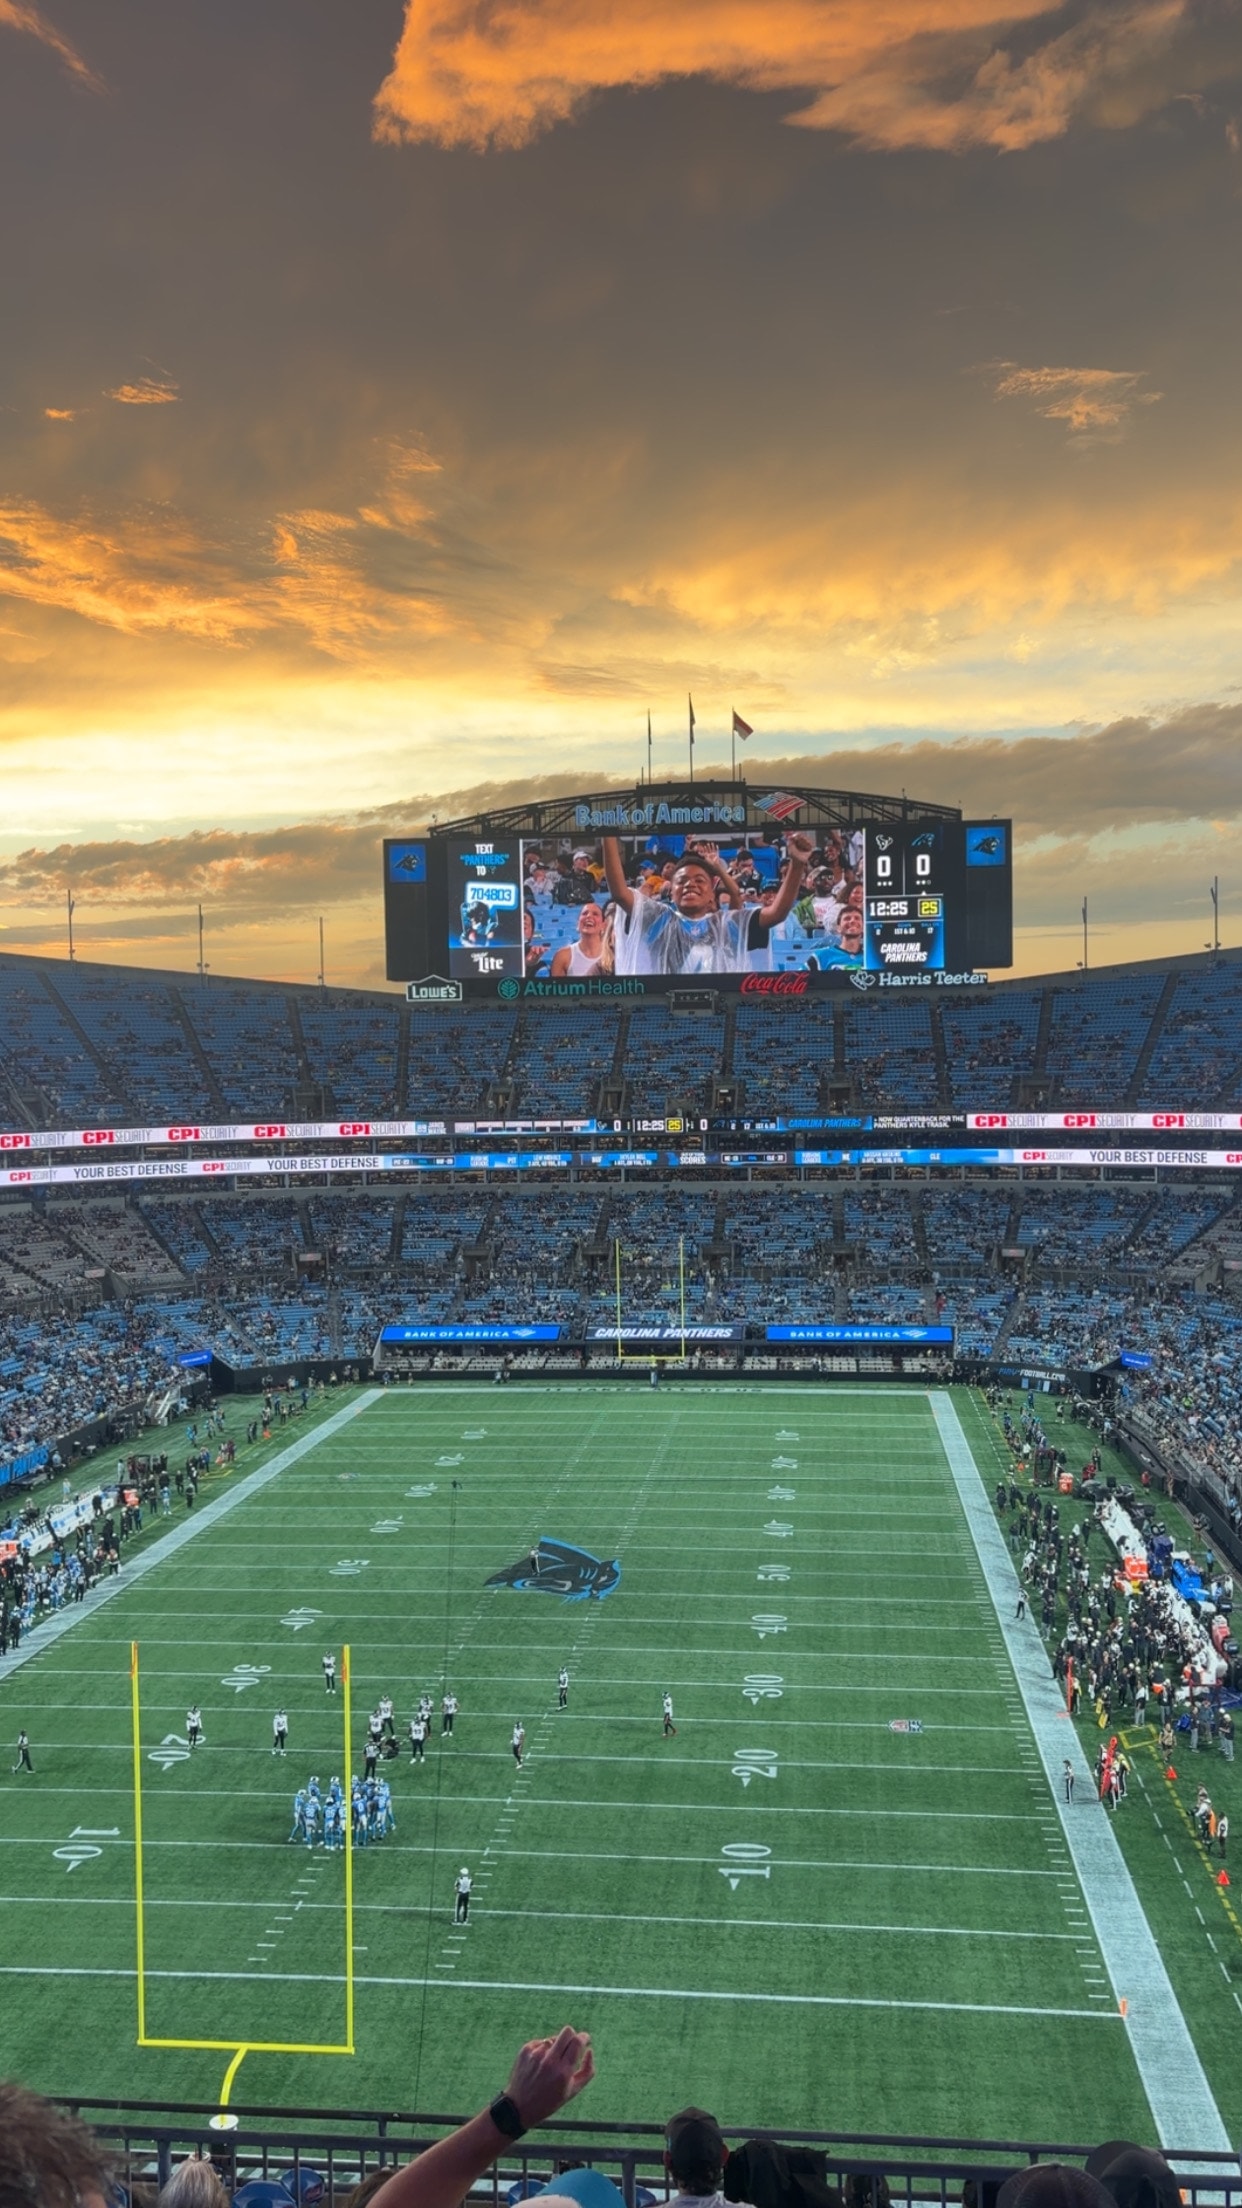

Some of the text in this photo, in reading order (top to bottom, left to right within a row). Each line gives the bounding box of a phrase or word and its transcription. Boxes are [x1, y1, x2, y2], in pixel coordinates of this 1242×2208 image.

[575, 801, 745, 827] Bank of America
[475, 844, 494, 854] TEXT
[476, 865, 487, 876] TO
[877, 853, 930, 877] 0 0
[470, 887, 512, 902] 704803
[870, 901, 938, 917] 12:25 25
[880, 942, 922, 954] CAROLINA
[884, 951, 928, 963] PANTHERS
[477, 956, 504, 973] Lite
[879, 970, 987, 985] Harris Teeter
[411, 984, 457, 998] LOWE'S
[524, 977, 645, 997] Atrium Health
[613, 1119, 621, 1131] 0
[637, 1119, 664, 1131] 12:25
[668, 1119, 681, 1130] 25
[701, 1118, 708, 1131] 0
[788, 1118, 862, 1129] CAROLINA PANTHERS
[874, 1121, 907, 1129] PANTHERS
[975, 1114, 1045, 1127] CPI SECURITY
[1063, 1114, 1134, 1127] CPI SECURITY
[1151, 1115, 1223, 1127] CPI SECURITY
[168, 1126, 238, 1141] CPI SECURITY
[254, 1125, 325, 1137] CPI SECURITY
[339, 1124, 370, 1135] CPI
[371, 1123, 408, 1135] SECURITY
[0, 1133, 68, 1148] CPI SECURITY
[82, 1130, 152, 1144] CPI SECURITY
[1023, 1152, 1045, 1160] CPI
[1089, 1151, 1207, 1164] YOUR BEST DEFENSE
[1226, 1154, 1242, 1163] CP
[202, 1163, 224, 1172] CPI
[267, 1157, 379, 1171] YOUR BEST DEFENSE
[9, 1172, 31, 1182] CPI
[74, 1163, 188, 1179] YOUR BEST DEFENSE
[456, 1330, 509, 1338] AMERICA
[595, 1328, 732, 1338] CAROLINA PANTHERS
[328, 1559, 371, 1575] 50
[757, 1564, 791, 1581] 50
[279, 1606, 323, 1624] 40
[750, 1614, 787, 1634] 40
[220, 1663, 272, 1686] 30
[742, 1674, 783, 1698] 30
[731, 1748, 778, 1778] 20
[53, 1826, 121, 1860] 10
[718, 1842, 772, 1879] 10
